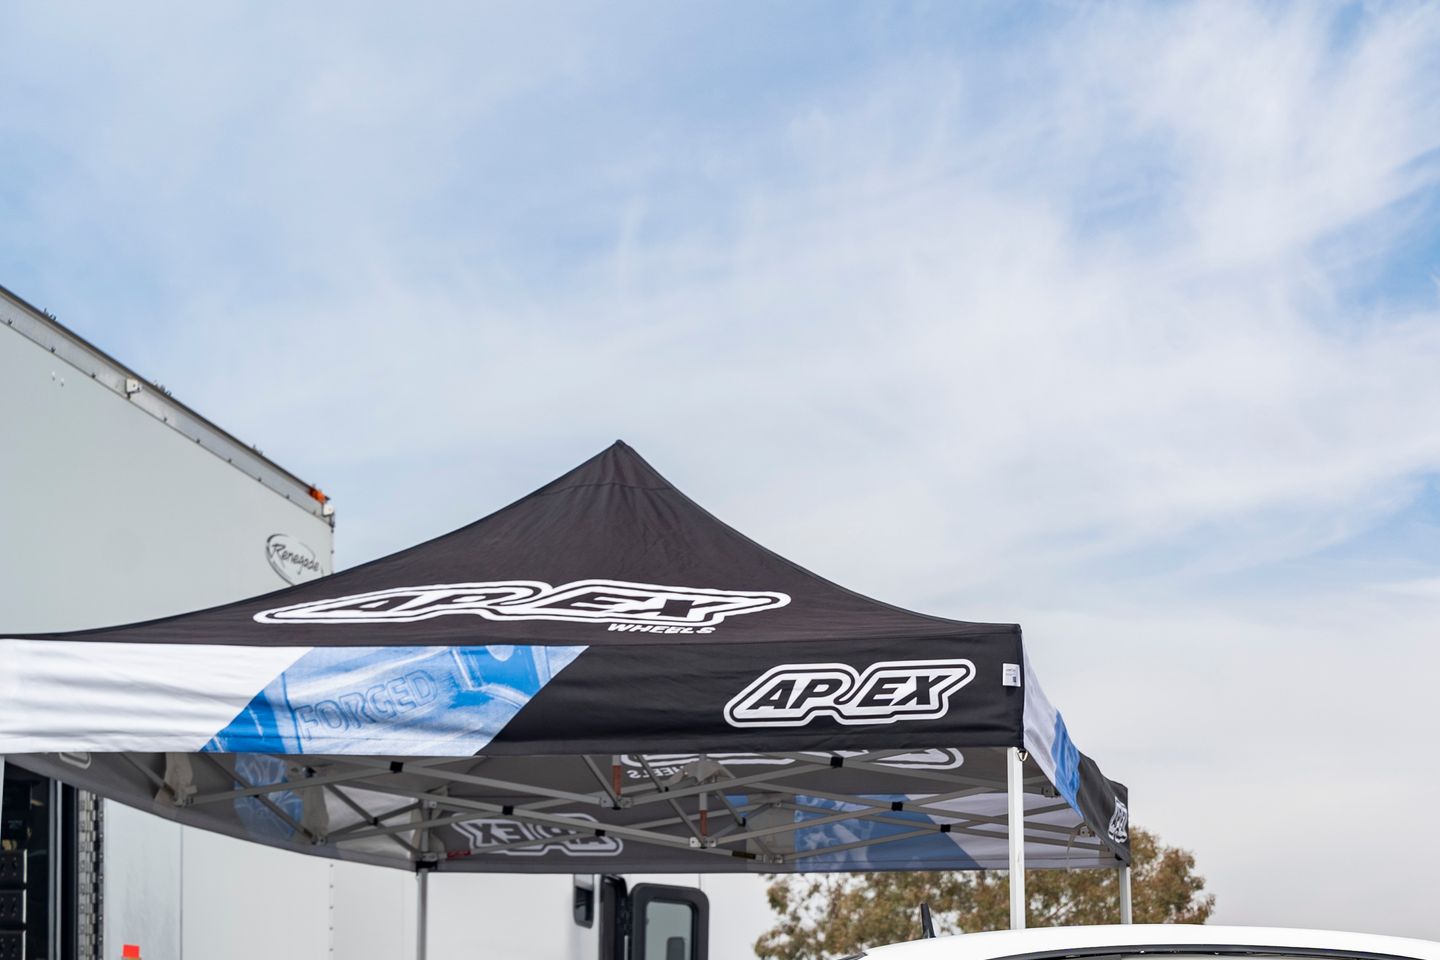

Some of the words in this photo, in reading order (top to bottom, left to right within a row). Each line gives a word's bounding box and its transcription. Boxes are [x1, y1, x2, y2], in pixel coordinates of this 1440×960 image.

[270, 543, 320, 575] Renegade
[296, 588, 752, 620] APEX
[608, 623, 716, 634] WHEELS
[294, 669, 438, 742] FORGED
[742, 670, 957, 712] APEX
